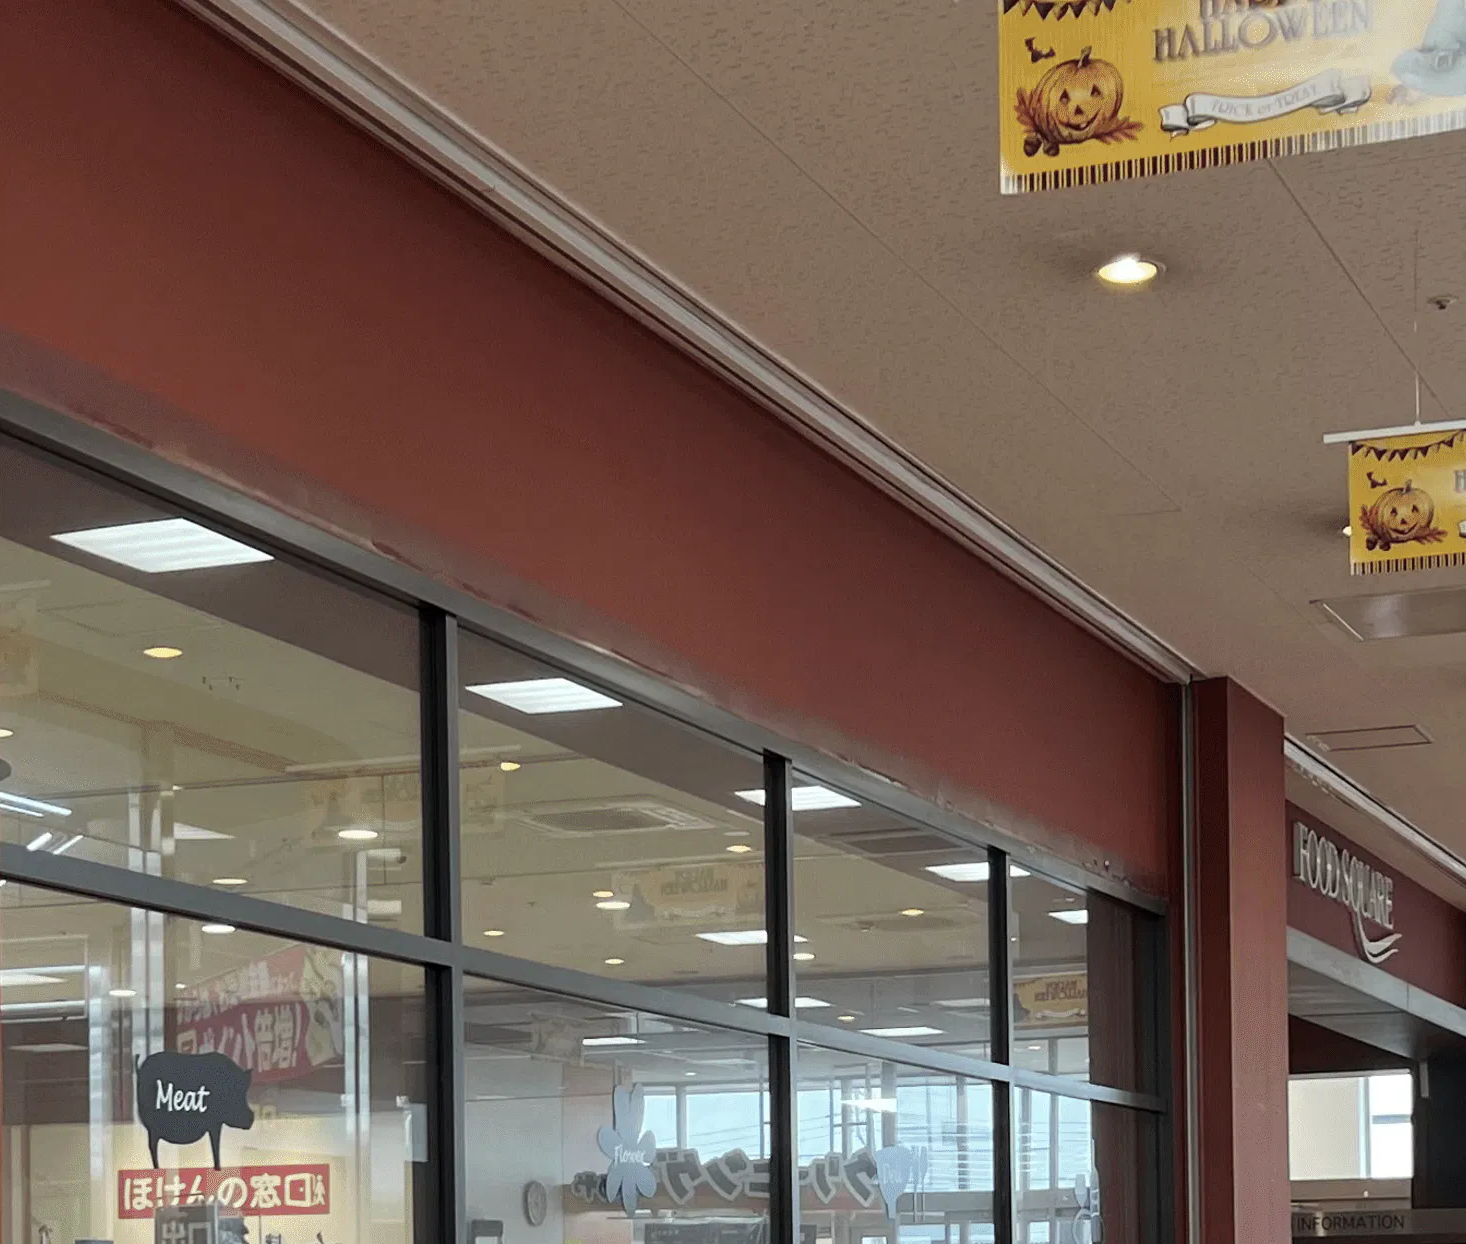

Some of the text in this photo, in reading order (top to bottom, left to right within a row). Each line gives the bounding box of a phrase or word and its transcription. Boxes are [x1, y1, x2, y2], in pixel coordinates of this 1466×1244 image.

[1294, 821, 1400, 942] FOOD SQUARE
[156, 1079, 211, 1114] Meat
[1296, 1214, 1406, 1232] INFORMATION
